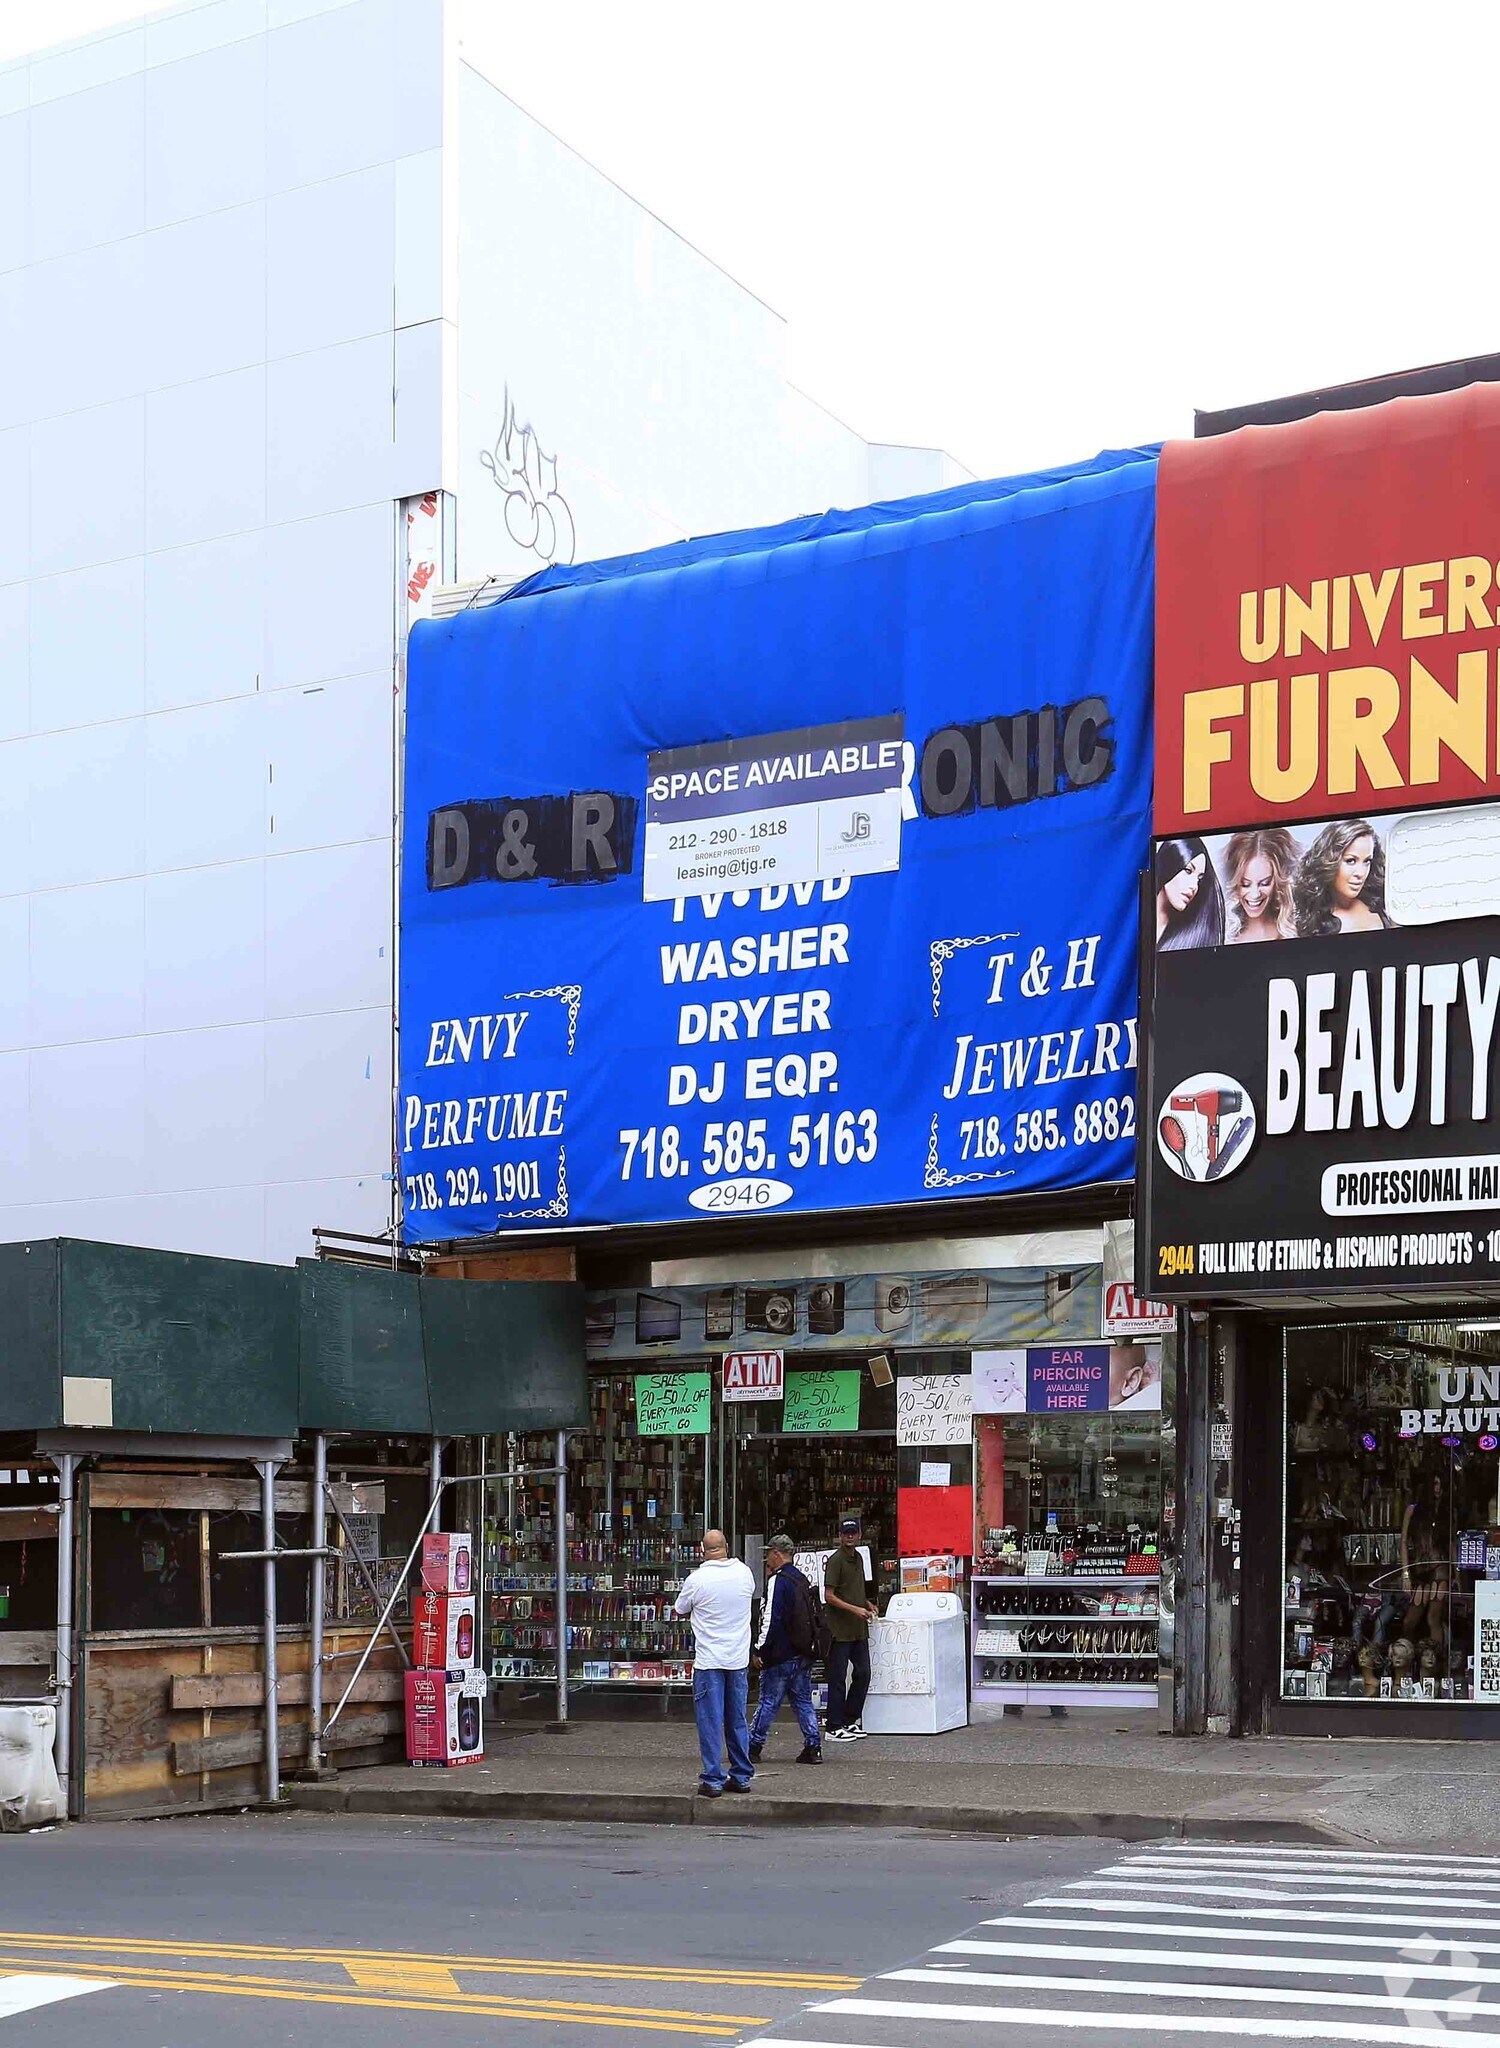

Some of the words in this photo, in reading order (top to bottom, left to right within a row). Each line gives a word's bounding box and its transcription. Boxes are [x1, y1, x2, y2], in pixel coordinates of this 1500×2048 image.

[1239, 555, 1500, 663] UNIVER
[1183, 648, 1500, 814] FURN
[652, 764, 740, 802] SPACE
[745, 740, 902, 788] AVAILABLE
[432, 810, 471, 888] D
[496, 809, 538, 880] &
[571, 793, 617, 872] R
[668, 833, 698, 851] 212
[709, 827, 738, 845] 290
[749, 819, 788, 840] 1818
[694, 850, 722, 861] BROKER
[723, 844, 761, 857] PROTECTED
[676, 855, 777, 880] leasing@tjg.re
[660, 923, 850, 985] WASHER
[986, 953, 1016, 1005] T
[1020, 946, 1054, 998] &
[1061, 934, 1102, 992] H
[678, 989, 832, 1046] DRYER
[425, 1010, 530, 1068] ENVY
[668, 1060, 727, 1107] DJ
[745, 1051, 839, 1101] EQP.
[402, 1089, 568, 1153] PERFUME
[959, 1117, 1006, 1161] 718.
[1013, 1105, 1066, 1156] 585.
[1073, 1095, 1137, 1145] 8882
[619, 1123, 690, 1182] 718.
[703, 1118, 776, 1176] 585.
[789, 1108, 878, 1168] 5163
[406, 1172, 443, 1211] 718.
[446, 1166, 489, 1207] 292.
[492, 1160, 542, 1203] 1901
[706, 1183, 771, 1208] 2946
[1336, 1168, 1462, 1207] PROFESSIONAL
[1469, 1165, 1500, 1200] HAI
[1158, 1245, 1195, 1276] 2944
[1198, 1242, 1227, 1274] FULL
[1228, 1241, 1256, 1273] LINE
[1257, 1240, 1274, 1272] OF
[1275, 1237, 1322, 1271] ETHNIC
[1323, 1242, 1334, 1270] &
[1335, 1234, 1399, 1269] HISPANIC
[1400, 1230, 1473, 1267] PRODUCTS
[726, 1354, 778, 1387] ATM
[1051, 1350, 1084, 1365] EAR
[650, 1373, 687, 1389] SALES
[799, 1371, 835, 1387] SALES
[911, 1375, 962, 1391] SALES
[1033, 1366, 1102, 1381] PIERCING
[1435, 1365, 1500, 1403] UN
[692, 1388, 710, 1403] OFF
[1045, 1382, 1090, 1393] AVAILABLE
[639, 1406, 668, 1423] EVERY
[1046, 1394, 1087, 1409] HERE
[645, 1420, 670, 1432] MUST
[677, 1418, 691, 1430] GO
[786, 1409, 814, 1422] EVER
[791, 1422, 811, 1431] MUST
[817, 1417, 832, 1429] GO
[899, 1414, 934, 1430] EVERY
[941, 1412, 972, 1425] THING
[1213, 1424, 1233, 1433] JESU
[1399, 1407, 1500, 1434] BEAUT
[904, 1428, 937, 1443] MUST
[945, 1426, 965, 1442] GO
[872, 1648, 920, 1668] OSING
